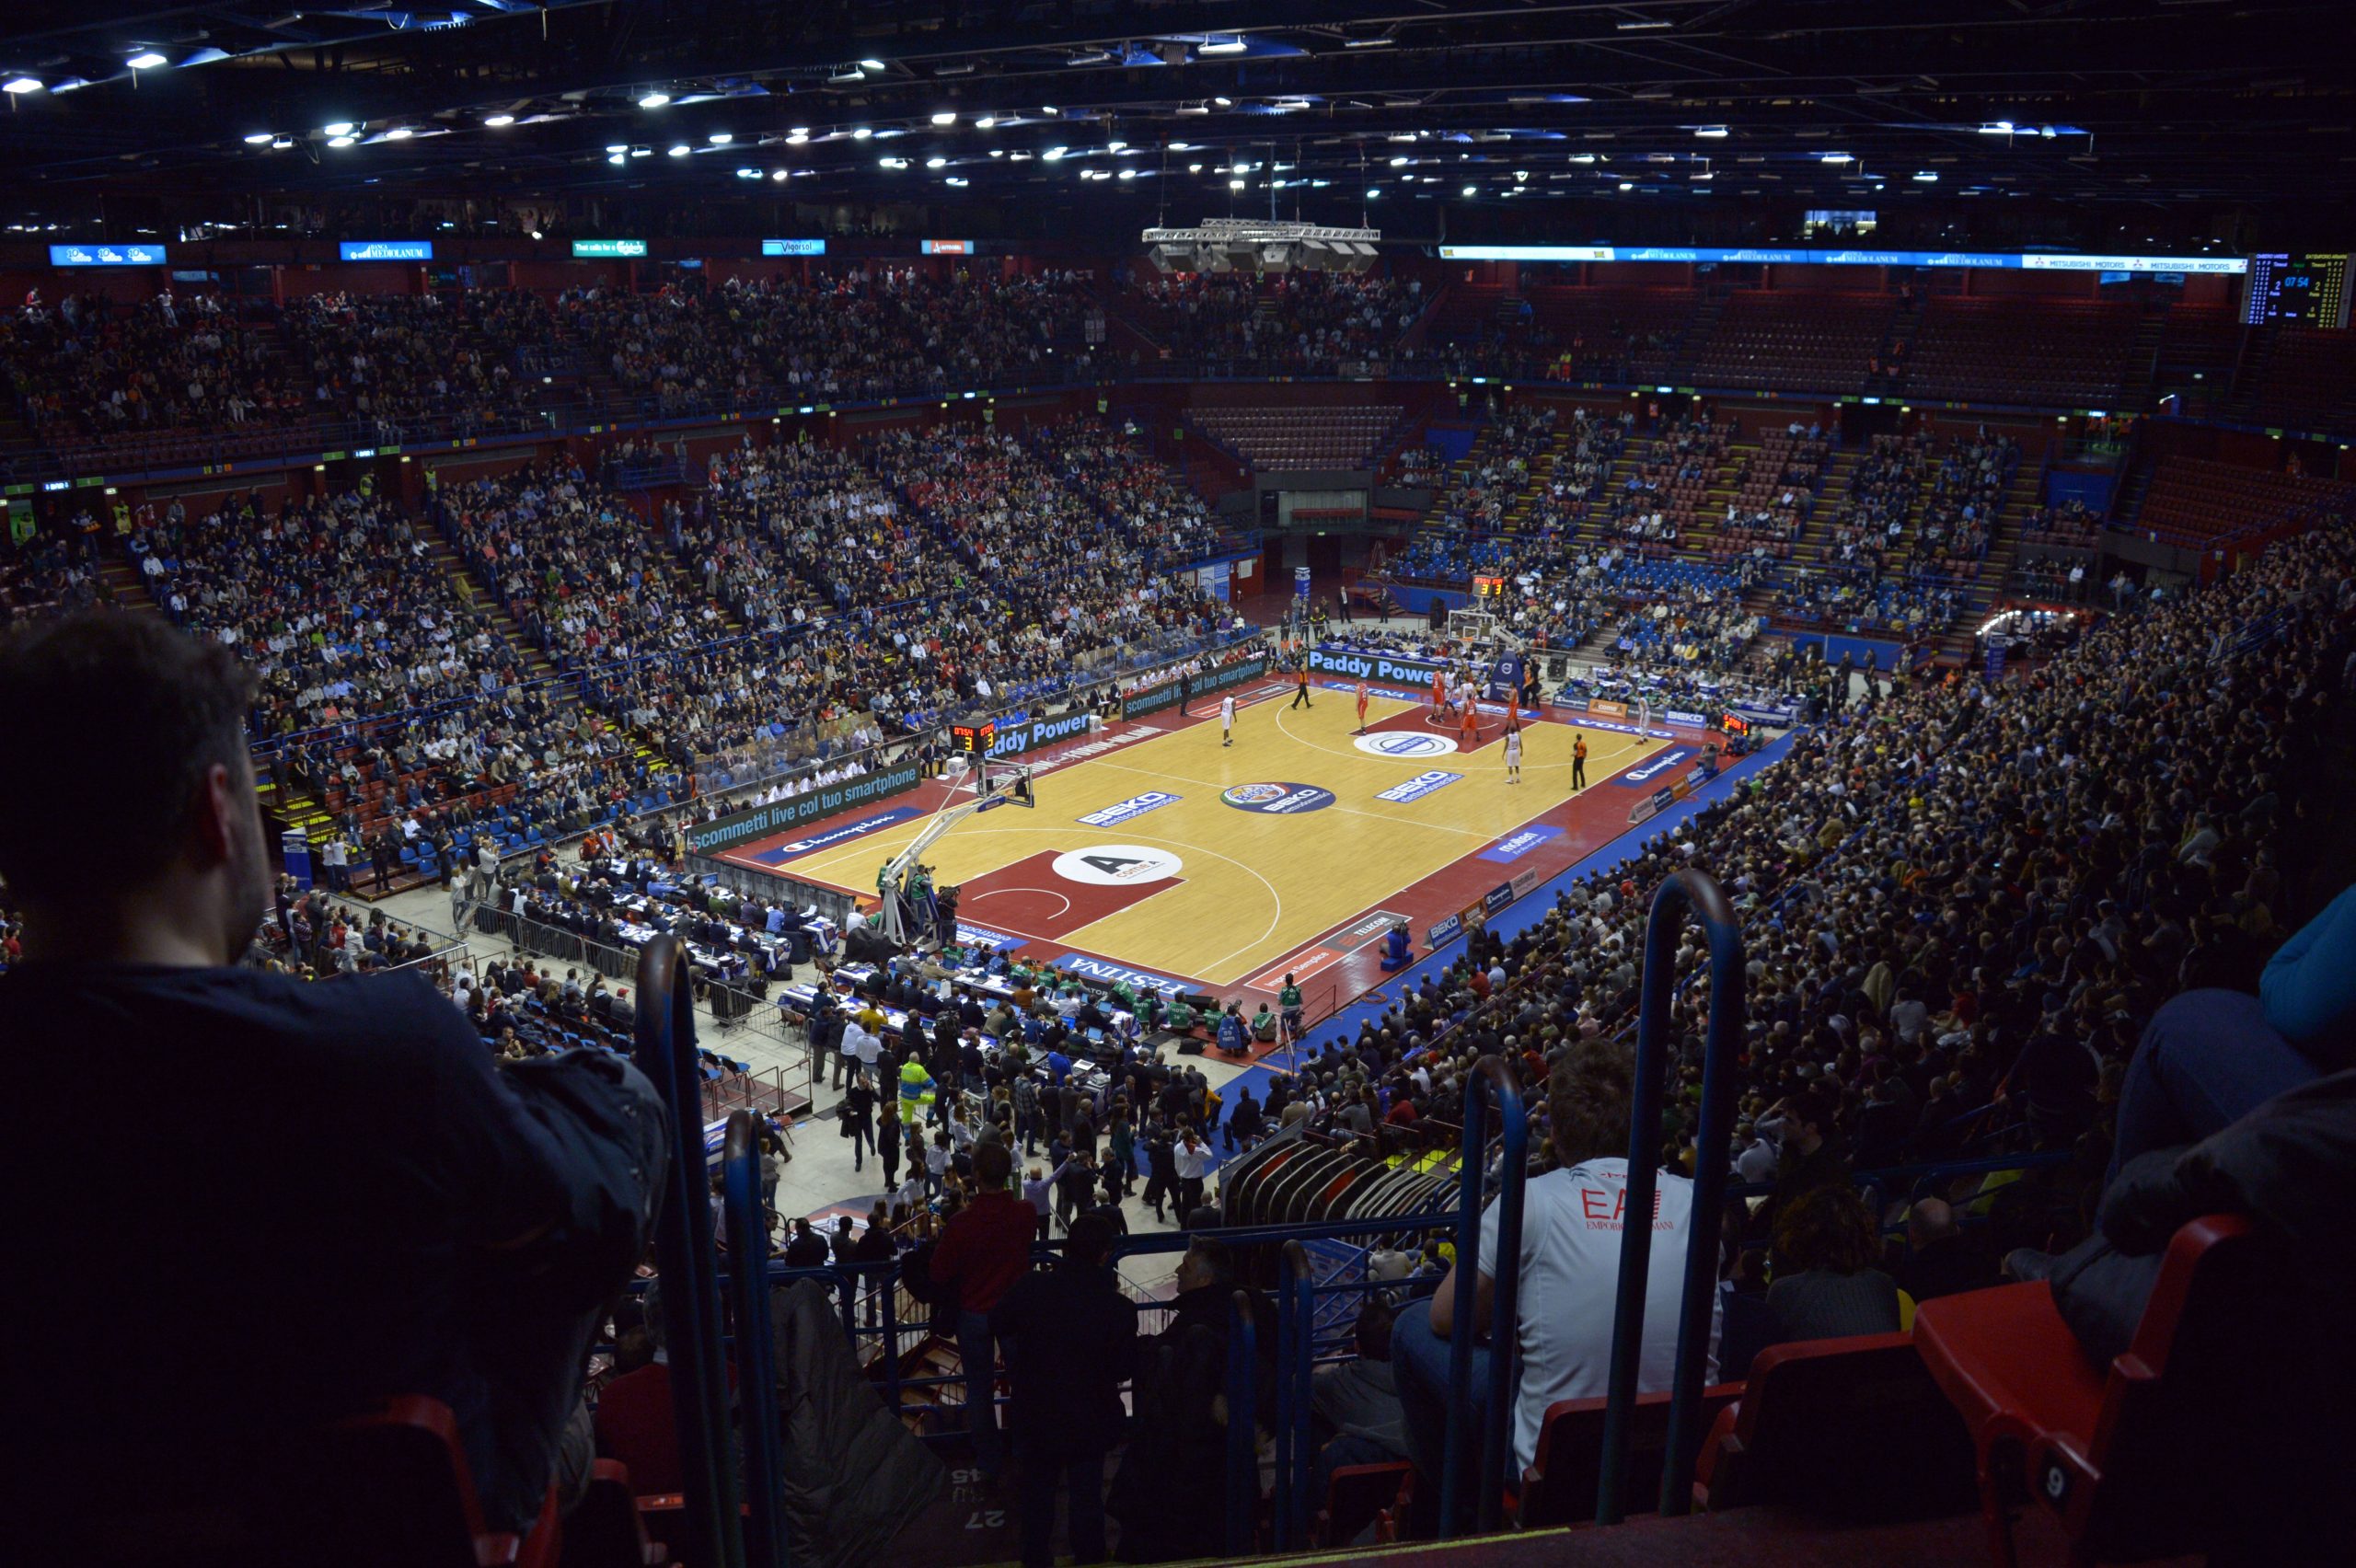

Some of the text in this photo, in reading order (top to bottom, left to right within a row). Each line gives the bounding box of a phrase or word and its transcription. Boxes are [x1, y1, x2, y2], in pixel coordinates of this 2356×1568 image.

[371, 249, 423, 258] MEDIOLANUM
[781, 241, 812, 253] Vigorsol
[1740, 253, 1791, 261] MEDIOLANUM
[1844, 255, 1899, 263] MEDIOLANUM
[1946, 258, 2003, 266] MEDIOLANUM
[1481, 584, 1488, 594] 3
[1496, 584, 1502, 595] 3
[1310, 651, 1433, 686] Paddy Powe
[1126, 688, 1172, 714] scommetti
[1190, 679, 1203, 694] col
[1204, 676, 1218, 691] tuo
[1218, 660, 1264, 684] smartphone
[1332, 683, 1405, 698] FETINA
[1555, 695, 1588, 707] Champion
[1667, 710, 1703, 722] BEKO
[984, 711, 1089, 759] addy Power
[1575, 718, 1673, 737] VOLVO
[964, 737, 972, 751] 3
[987, 732, 994, 748] 3
[1625, 751, 1686, 781] Champion
[1375, 770, 1449, 801] BEKO
[695, 767, 917, 850] scommetti live col tuo smartphone
[1078, 790, 1167, 824] BEKO
[1262, 789, 1318, 812] BEKO
[782, 814, 895, 853] Champion
[1498, 832, 1539, 853] molten
[1080, 855, 1146, 875] A
[1115, 862, 1149, 879] come
[1486, 887, 1510, 905] Champion
[957, 924, 1012, 941] elettrodo
[1353, 917, 1391, 936] TELECOM
[1430, 916, 1459, 939] BEKO
[1069, 958, 1188, 995] FESTINA
[1264, 951, 1330, 987] Imprsa Semplice
[1651, 1221, 1674, 1231] MANI
[965, 1509, 1006, 1530] 27
